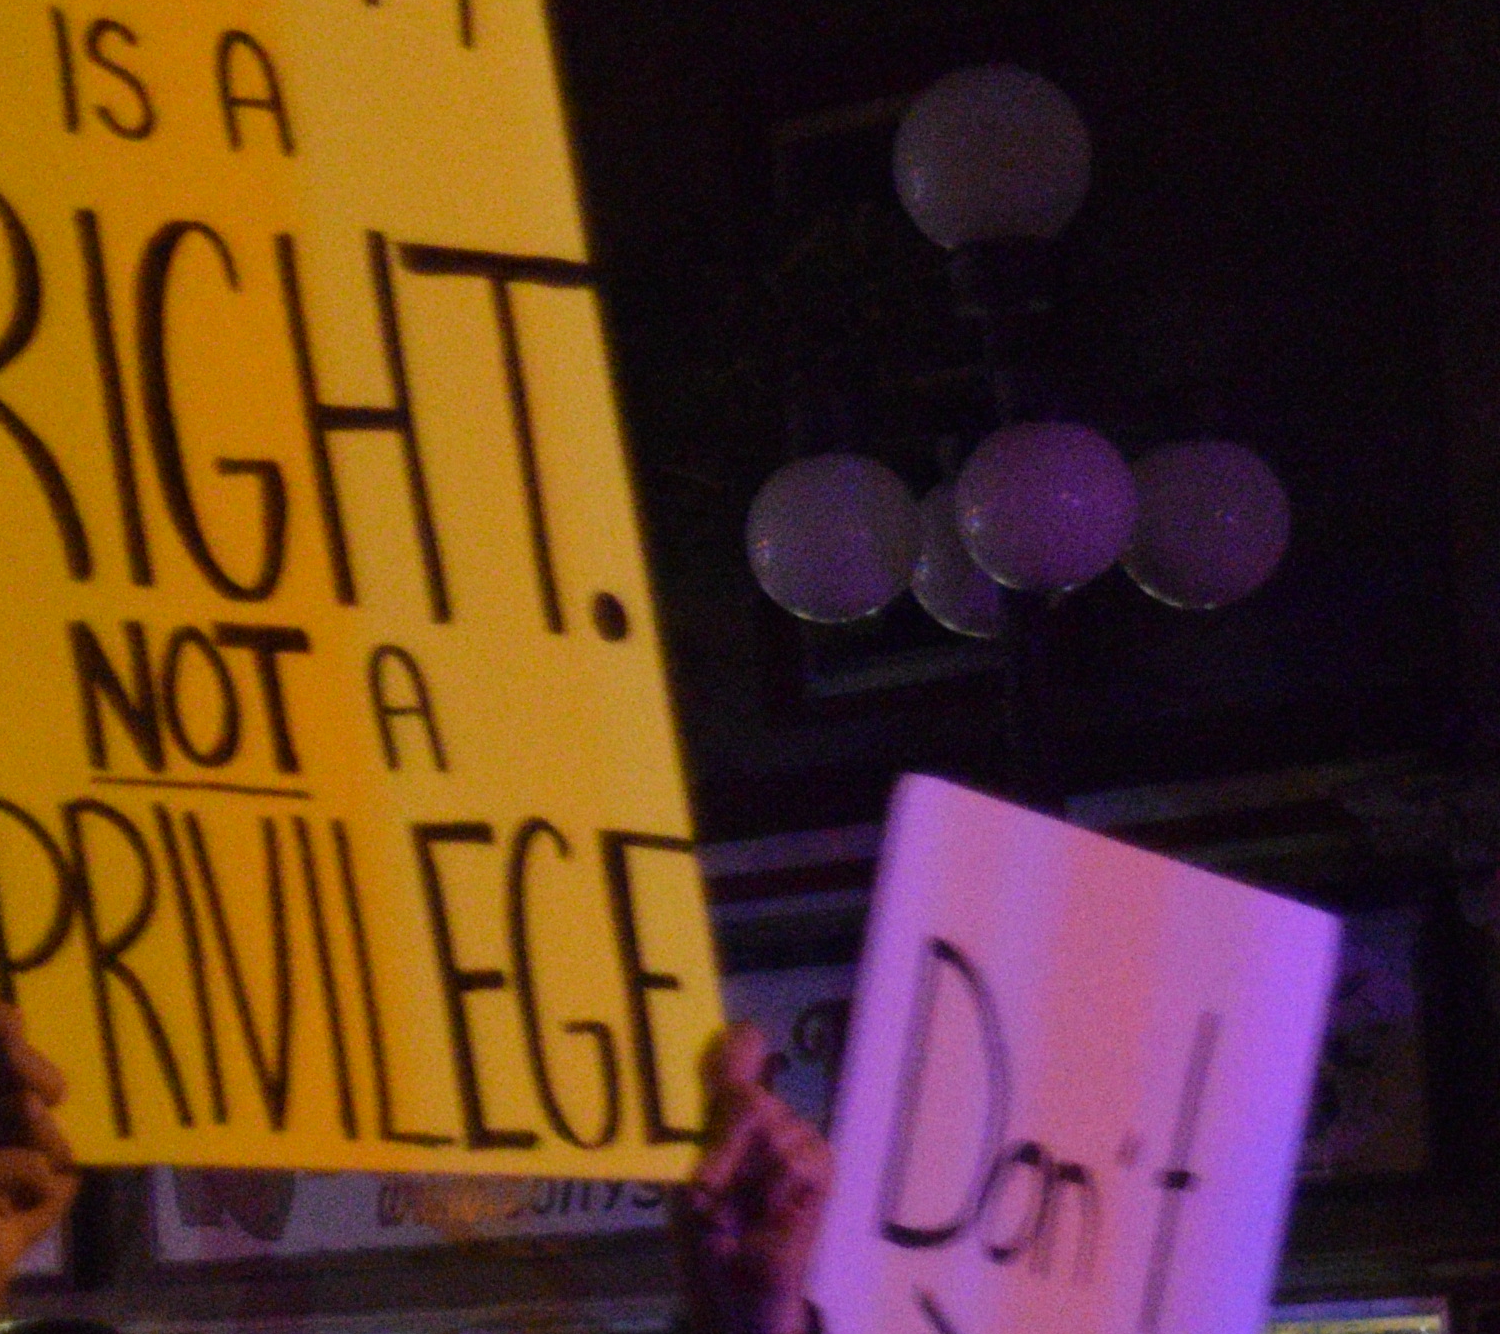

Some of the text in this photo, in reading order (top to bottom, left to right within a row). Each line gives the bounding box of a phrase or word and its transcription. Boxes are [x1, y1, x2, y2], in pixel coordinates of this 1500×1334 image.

[52, 7, 295, 153] IS A
[67, 620, 448, 773] NOT A
